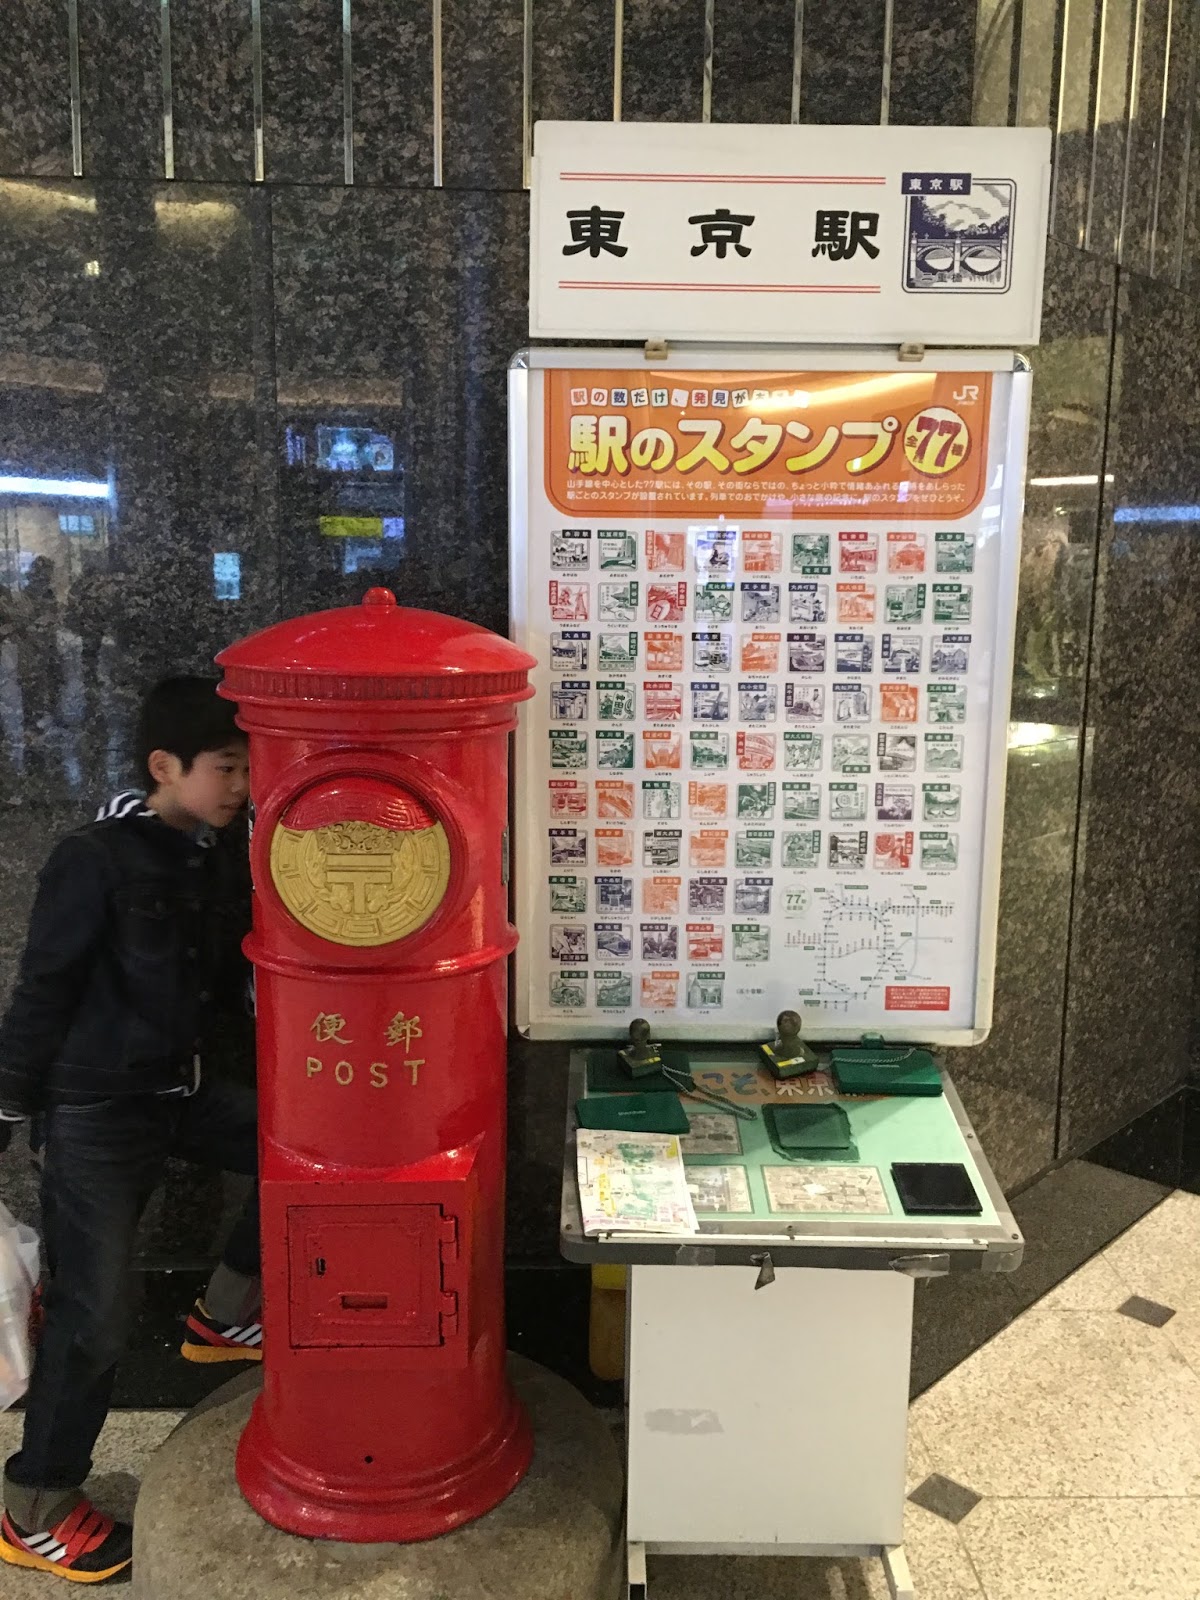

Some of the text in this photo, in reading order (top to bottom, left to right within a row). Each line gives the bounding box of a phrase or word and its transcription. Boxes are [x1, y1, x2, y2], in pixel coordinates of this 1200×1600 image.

[908, 178, 963, 191] 東京駅
[562, 205, 880, 261] 東京駅
[572, 389, 808, 405] 駅の数だけ、発見が
[952, 385, 979, 401] JR
[567, 413, 901, 477] 駅のスタンプ
[306, 1057, 425, 1088] POST
